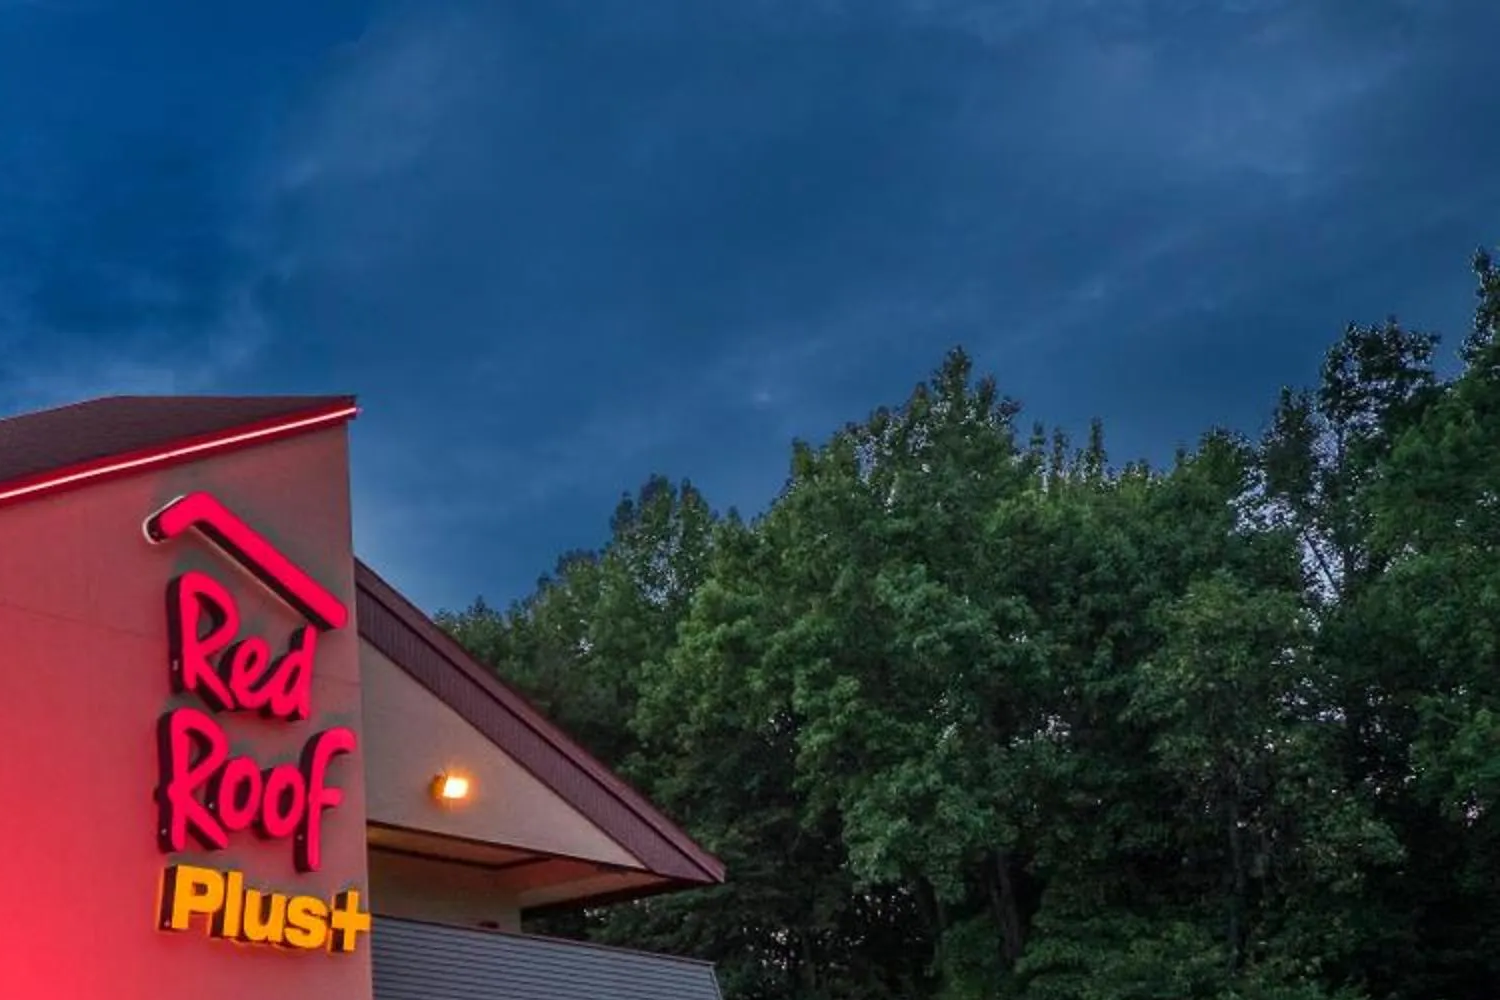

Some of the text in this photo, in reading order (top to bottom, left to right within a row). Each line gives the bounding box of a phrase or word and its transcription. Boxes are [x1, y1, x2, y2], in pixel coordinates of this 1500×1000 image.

[175, 570, 318, 720] Red
[164, 707, 358, 872] Roof
[169, 864, 372, 953] Plus+
